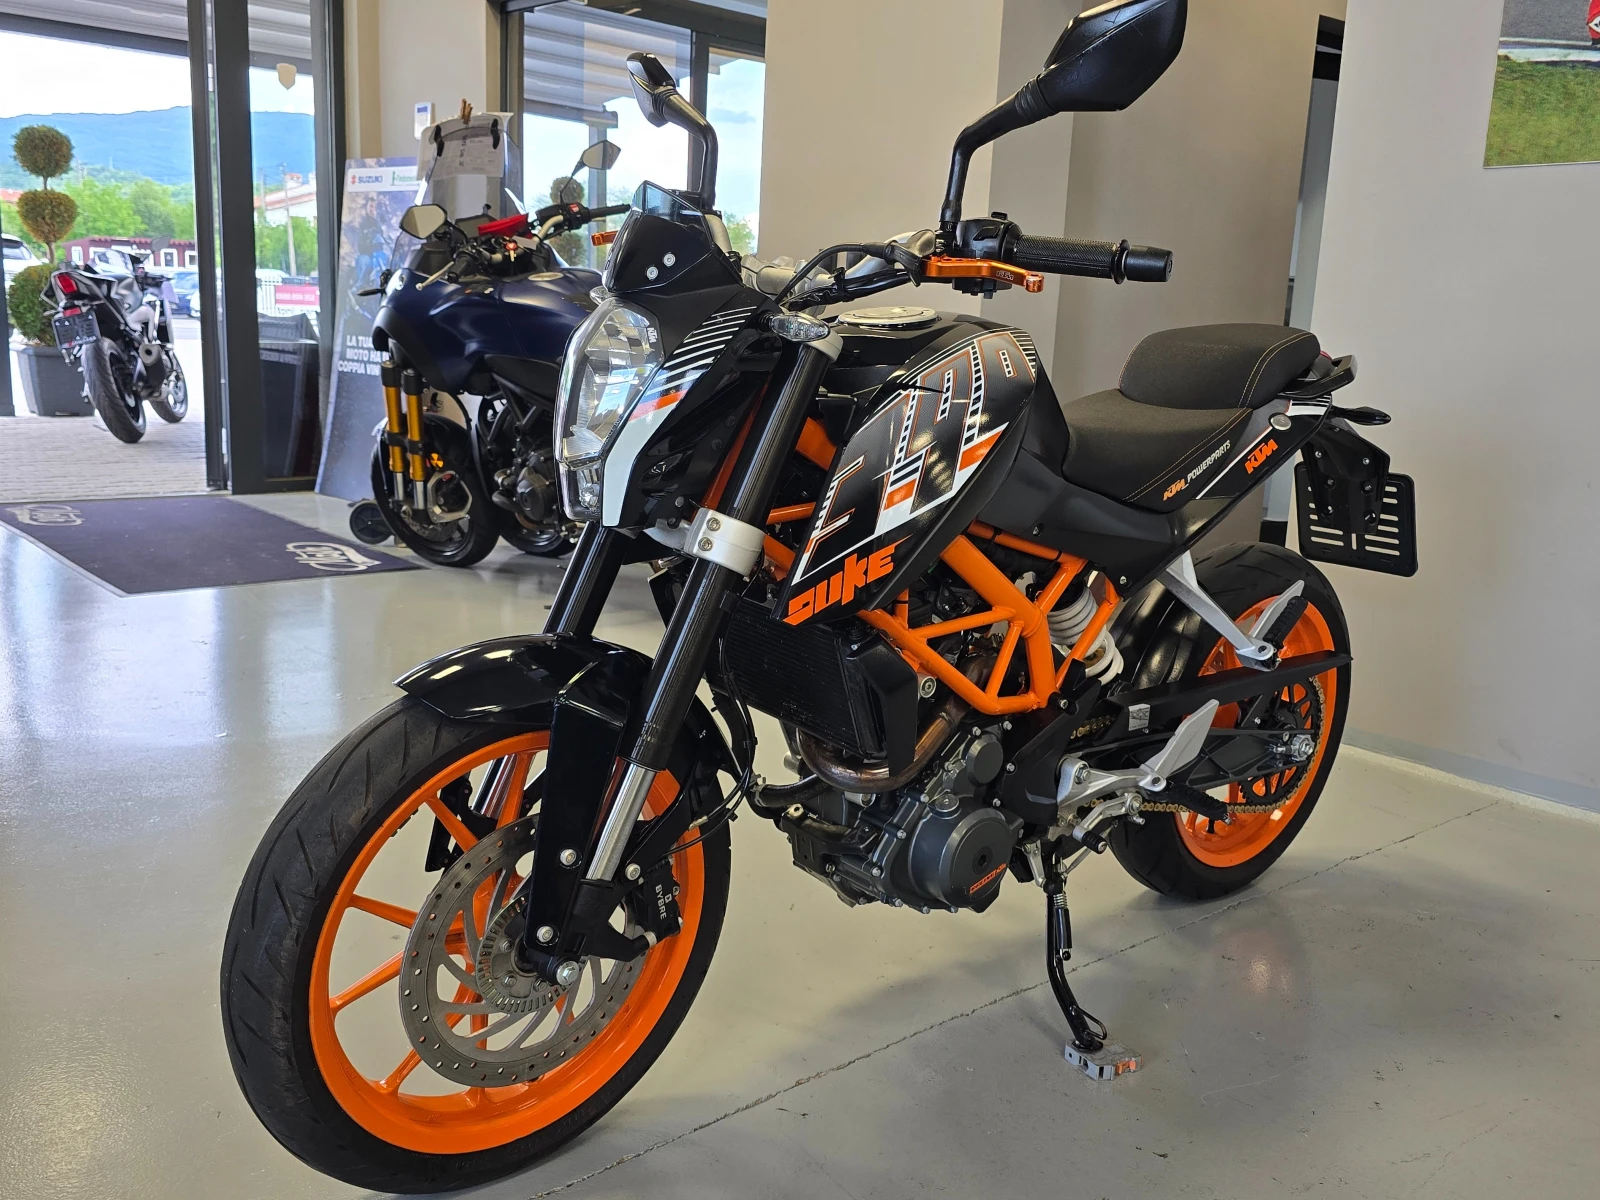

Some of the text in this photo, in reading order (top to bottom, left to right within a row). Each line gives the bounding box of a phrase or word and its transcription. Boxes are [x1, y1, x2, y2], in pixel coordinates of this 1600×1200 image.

[346, 335, 357, 347] LA
[646, 327, 658, 343] KTM
[338, 360, 365, 375] COPPIA
[346, 348, 370, 362] MOTO
[370, 350, 382, 363] HA
[1245, 439, 1278, 474] KTM
[1162, 440, 1231, 501] KTM POWERPARTS
[783, 535, 912, 626] DUKE
[655, 884, 666, 920] BYBRE
